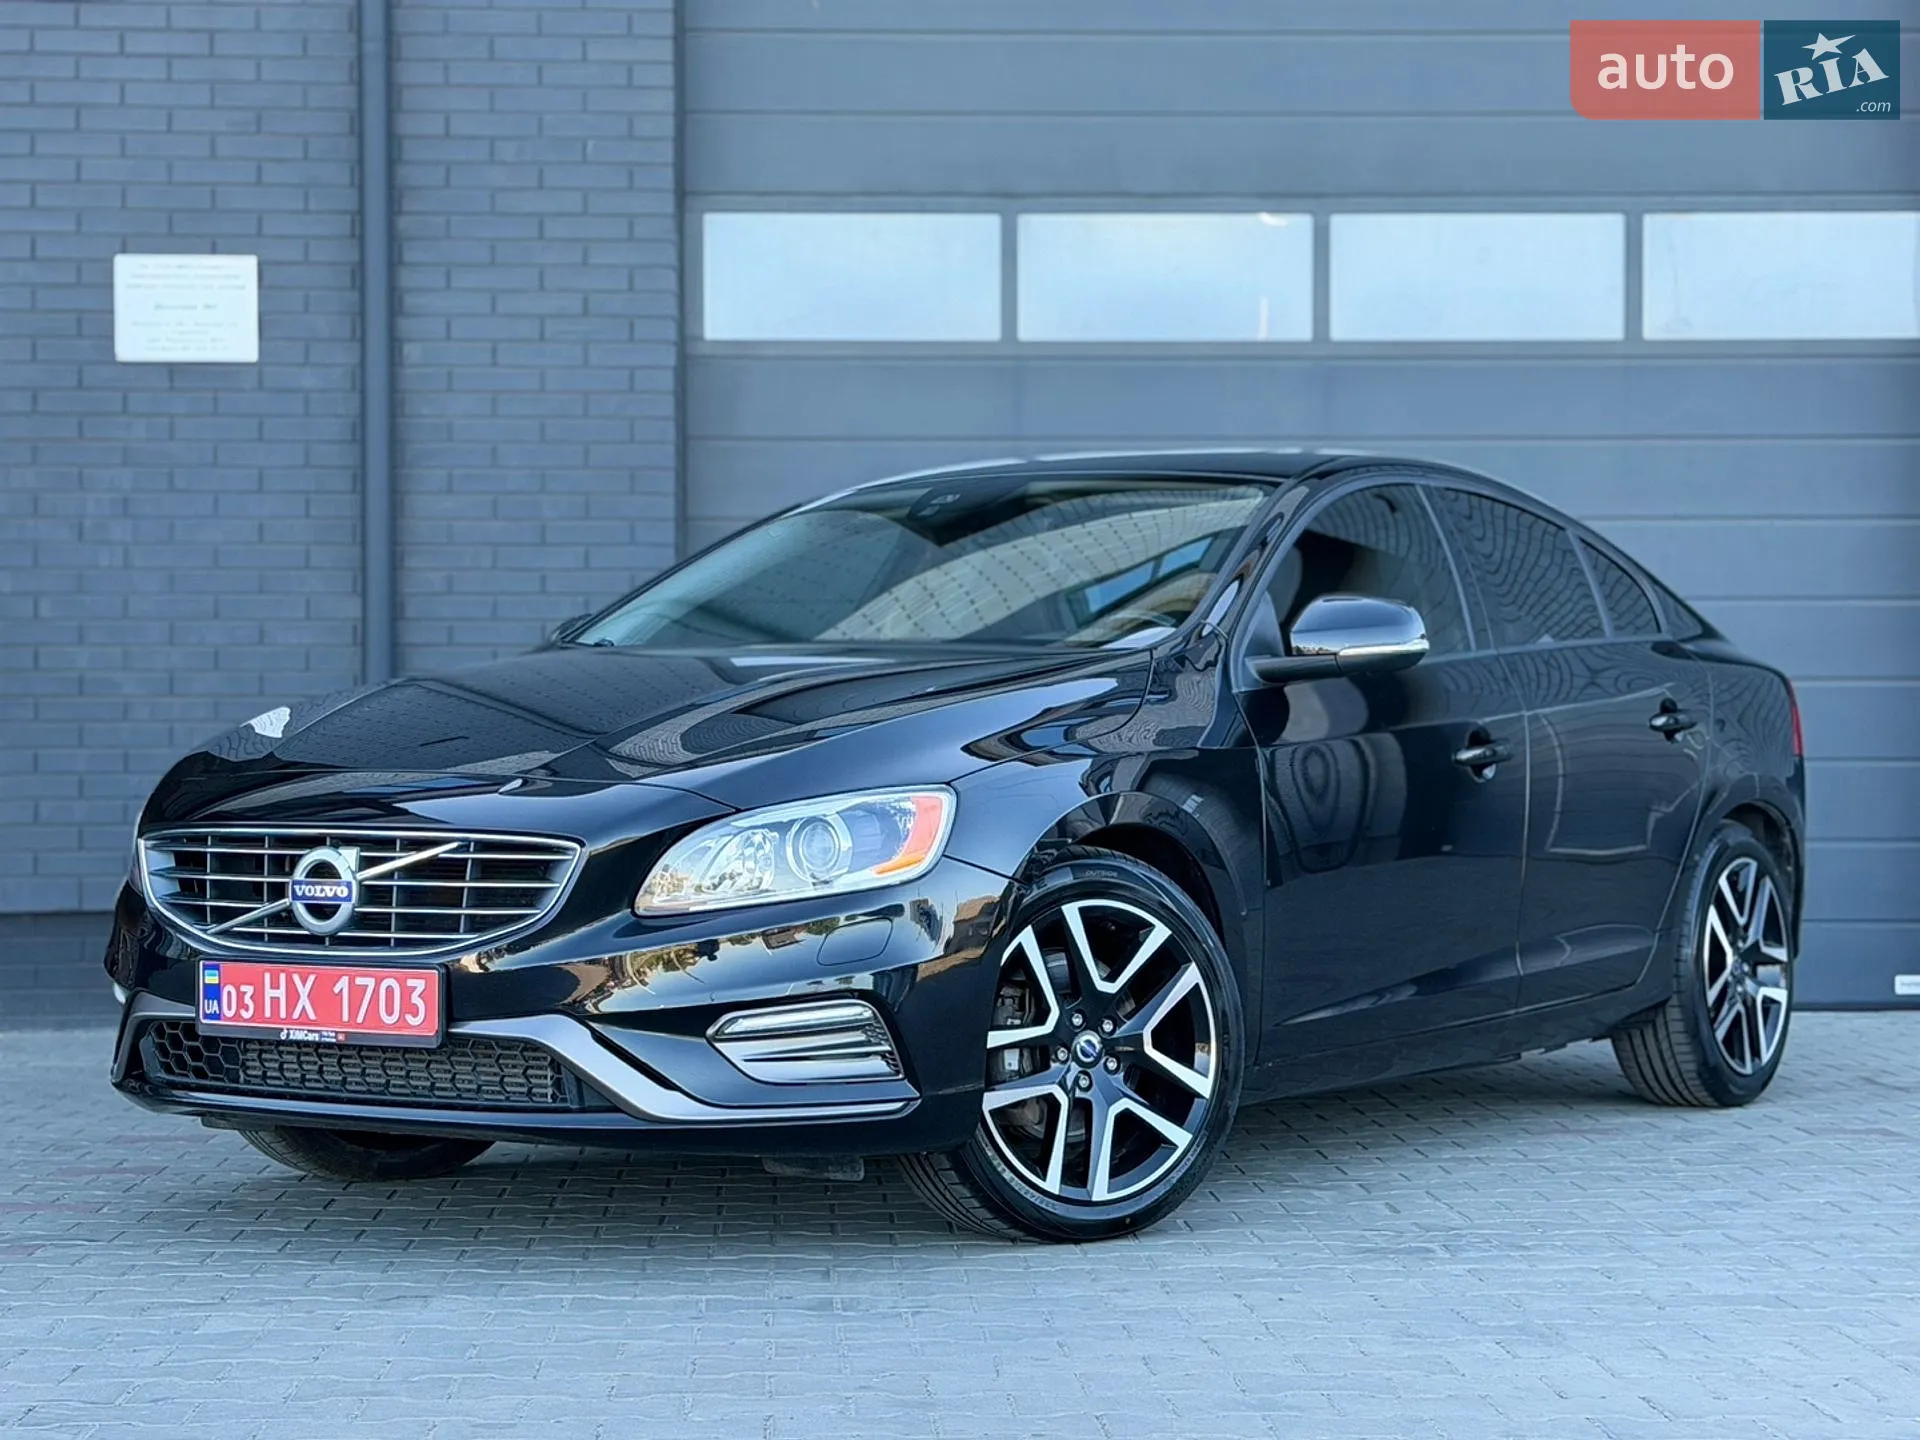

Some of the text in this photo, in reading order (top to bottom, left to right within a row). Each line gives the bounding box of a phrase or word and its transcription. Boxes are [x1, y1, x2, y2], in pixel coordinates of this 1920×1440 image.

[293, 885, 349, 898] VOLVO
[204, 999, 220, 1015] UA
[222, 972, 427, 1027] 03 HX 1703
